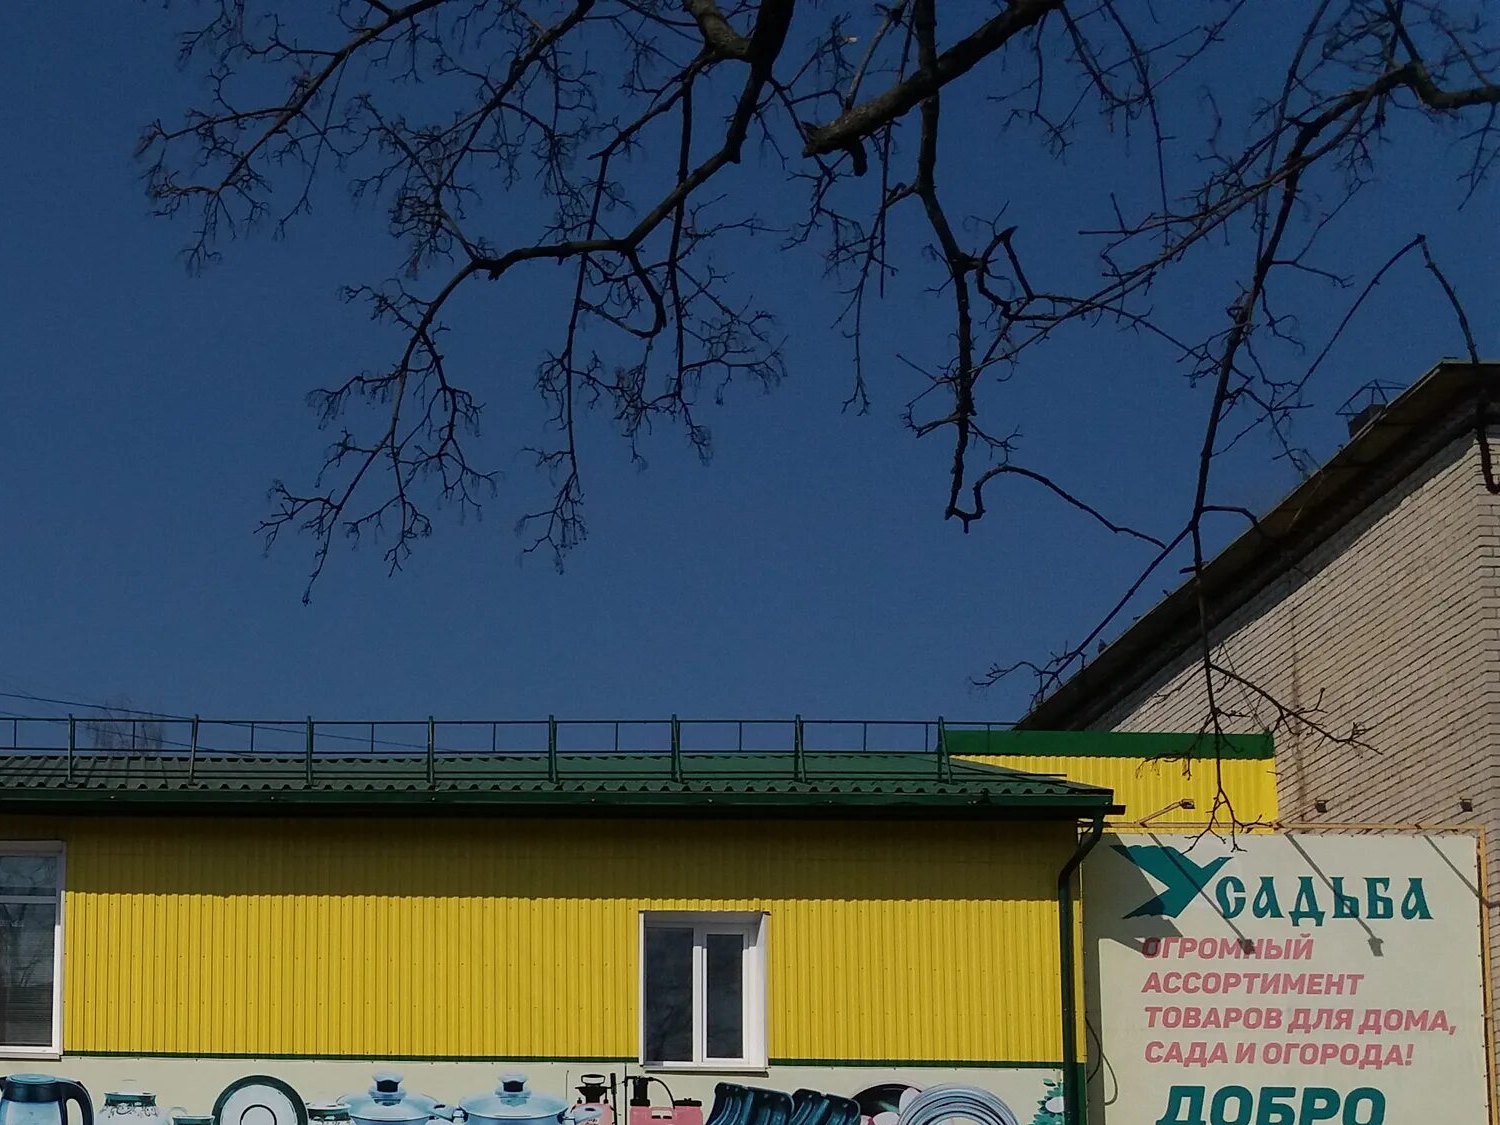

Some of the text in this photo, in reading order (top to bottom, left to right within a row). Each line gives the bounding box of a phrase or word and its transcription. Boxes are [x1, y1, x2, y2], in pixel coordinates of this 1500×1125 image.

[1141, 932, 1314, 961] ОГРОМНЫЙ
[1141, 972, 1364, 996] АССОРТИМЕНТ
[1144, 1006, 1457, 1036] ТОВАРОВ ДЛЯ ДОМА,
[1144, 1041, 1414, 1070] САДА И ОГОРОДА!
